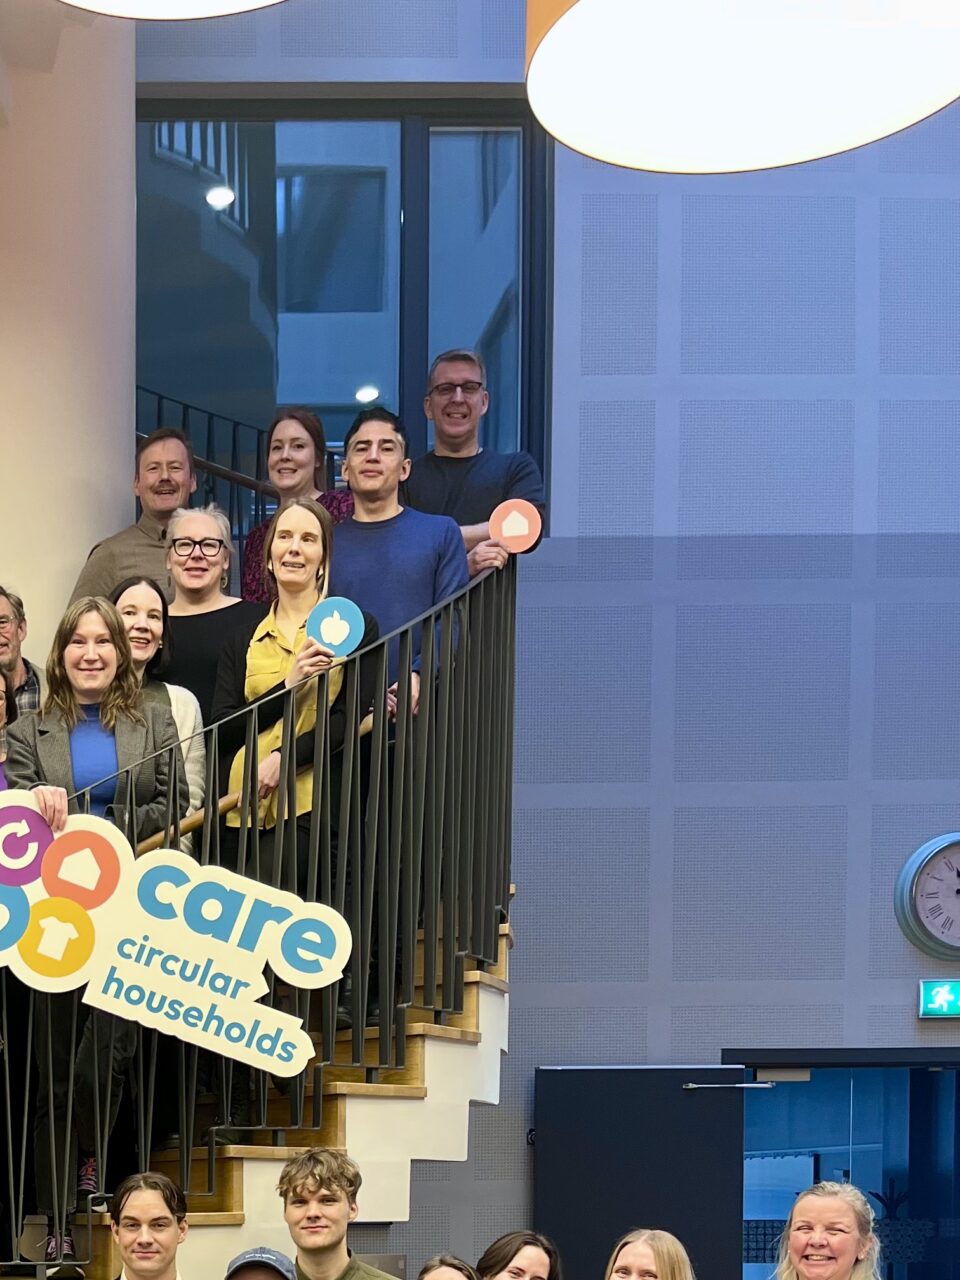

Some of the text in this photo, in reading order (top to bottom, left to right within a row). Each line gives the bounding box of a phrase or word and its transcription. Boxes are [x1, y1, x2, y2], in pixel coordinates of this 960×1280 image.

[116, 935, 251, 1000] circular
[136, 864, 337, 975] care
[101, 966, 298, 1064] households
